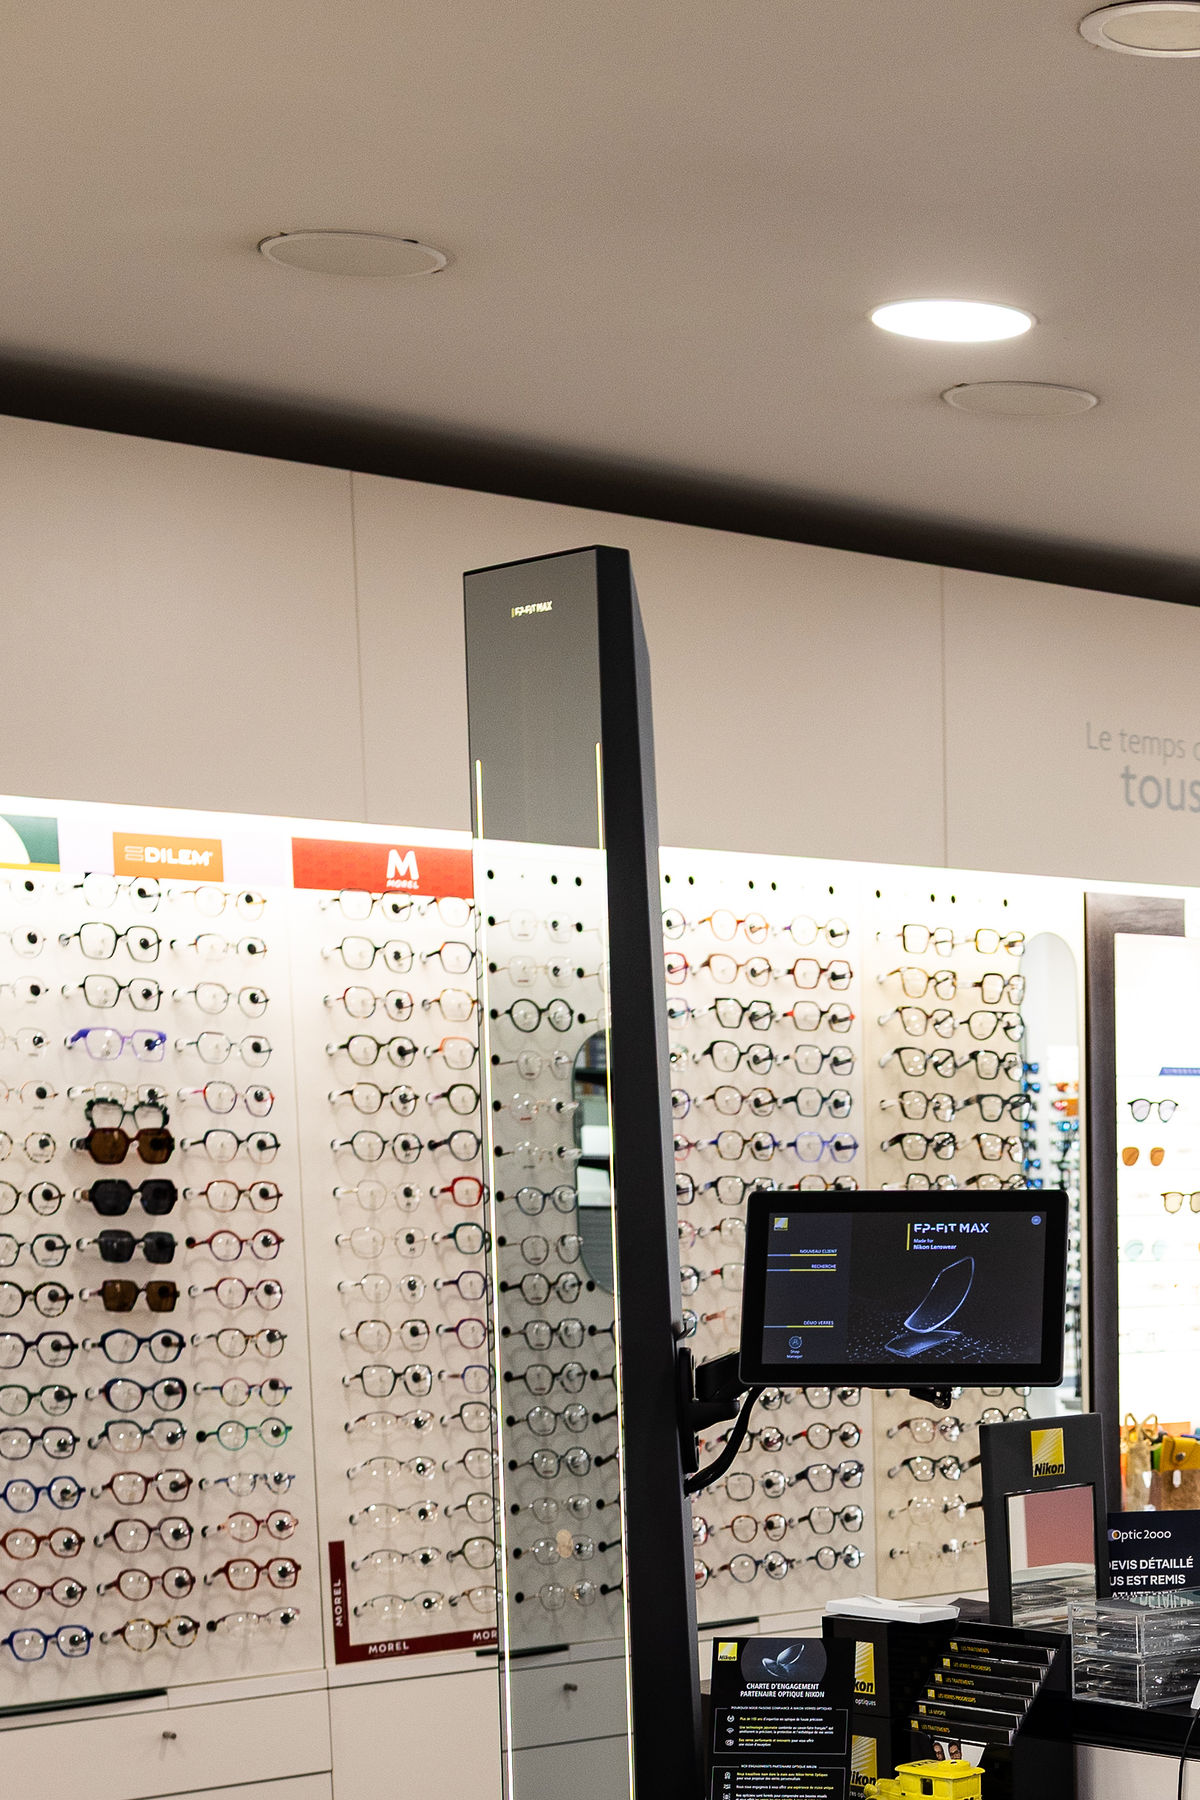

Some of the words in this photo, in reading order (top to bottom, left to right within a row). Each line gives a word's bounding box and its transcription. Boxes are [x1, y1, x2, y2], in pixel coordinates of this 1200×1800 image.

[1086, 721, 1112, 751] Le
[1119, 729, 1186, 765] temps
[144, 846, 213, 867] DILEM
[959, 1222, 990, 1233] MAX
[1034, 1462, 1064, 1476] Nikon
[1111, 1529, 1142, 1542] Optic
[1143, 1530, 1172, 1539] 2000
[1139, 1556, 1194, 1570] DÉTAILLÉ
[1110, 1576, 1124, 1586] US
[1126, 1575, 1149, 1586] EST
[1150, 1574, 1186, 1585] REMIS
[333, 1579, 343, 1627] MOREL
[368, 1641, 410, 1654] MOREL
[472, 1630, 497, 1641] MOR
[740, 1690, 777, 1698] PARTENAIRE
[851, 1770, 877, 1785] ikon
